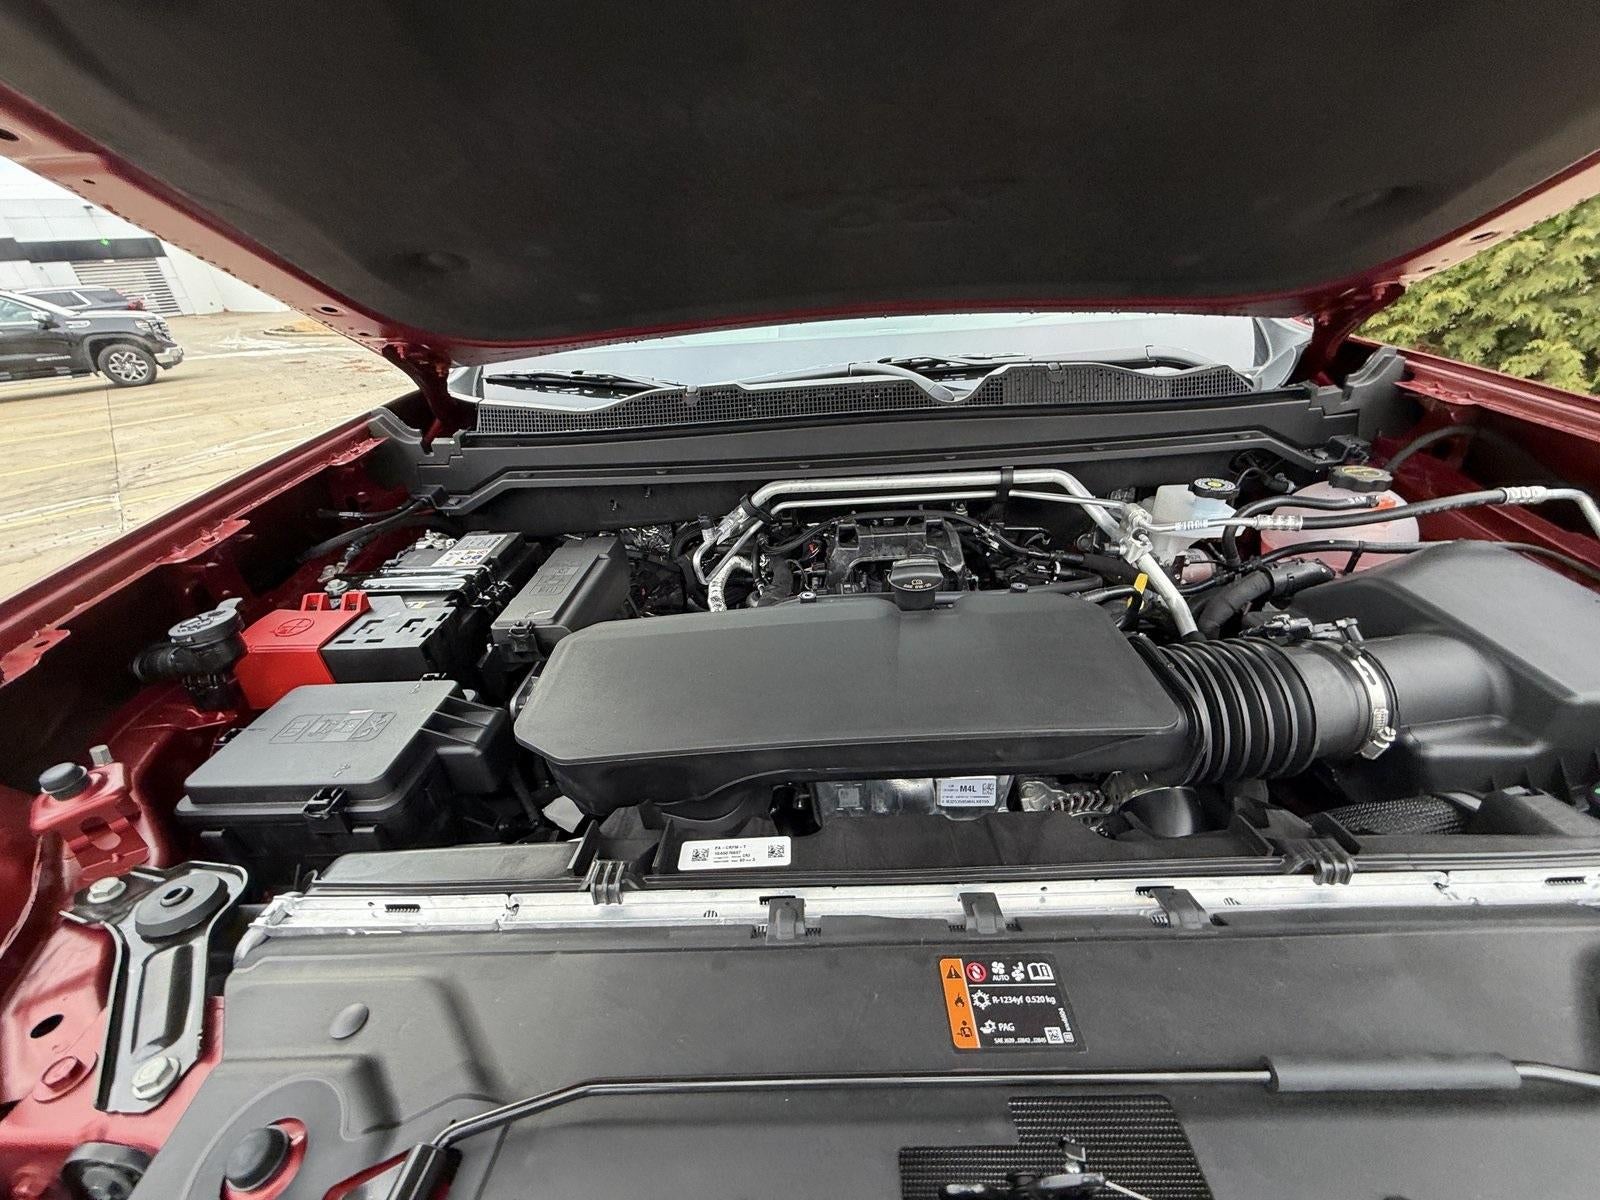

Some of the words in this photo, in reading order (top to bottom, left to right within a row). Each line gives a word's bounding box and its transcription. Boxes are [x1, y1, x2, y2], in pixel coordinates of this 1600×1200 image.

[992, 994, 1023, 1005] R-1234yf
[1025, 995, 1045, 1004] 0.520
[1046, 995, 1057, 1005] kg
[998, 1022, 1015, 1032] PAG
